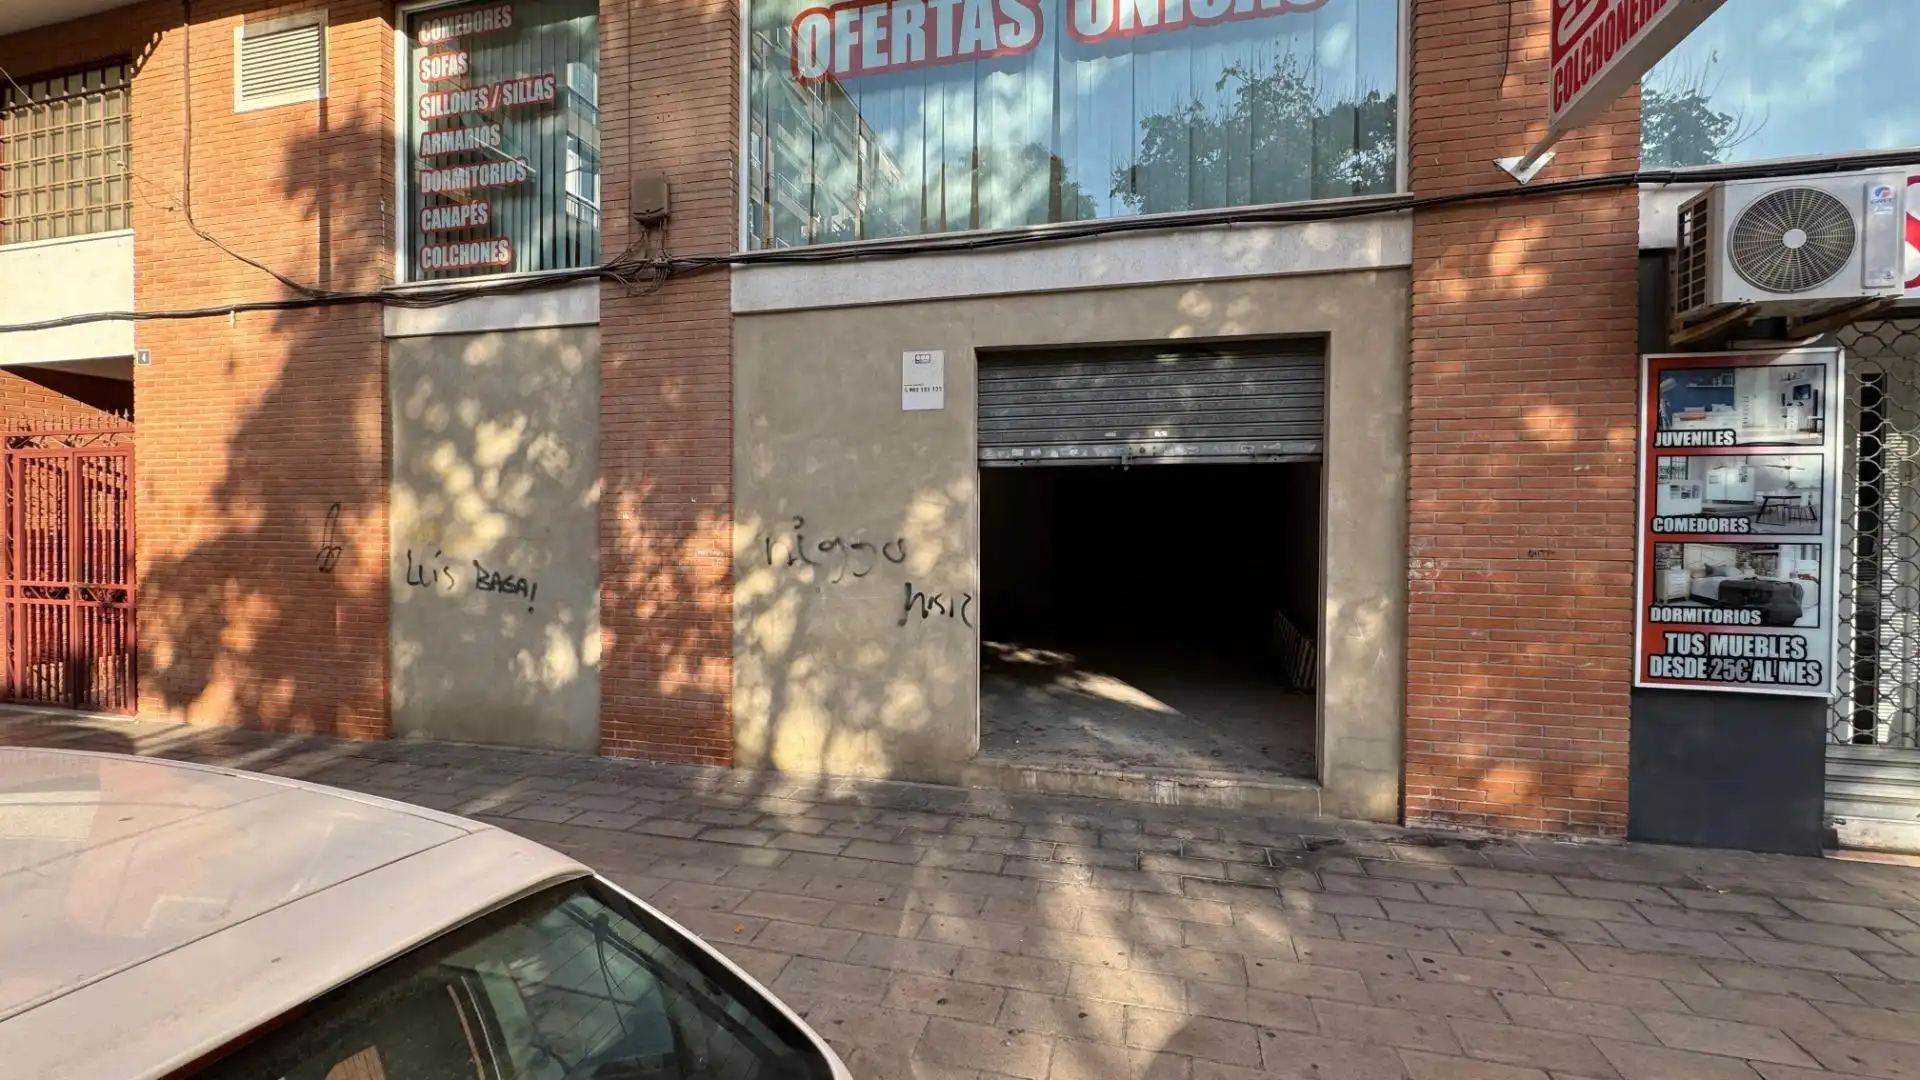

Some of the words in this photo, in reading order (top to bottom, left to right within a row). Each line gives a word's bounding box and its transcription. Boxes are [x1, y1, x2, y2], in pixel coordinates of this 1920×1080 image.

[420, 4, 513, 43] COMEDORES
[797, 0, 1037, 79] OFERTAS
[420, 51, 469, 82] SOFAS
[420, 87, 489, 120] SILLONES
[502, 76, 555, 106] SILLAS
[421, 123, 501, 157] ARMARIOS
[421, 158, 528, 194] DORMITORIOS
[421, 199, 489, 231] CANAPÉS
[421, 239, 510, 270] COLCHONES
[1654, 430, 1735, 448] JUVENILES
[1652, 516, 1749, 534] COMEDORES
[1649, 606, 1762, 626] DORMITORIOS
[1663, 632, 1706, 656] TUS
[1709, 633, 1806, 660] MUEBLES
[1649, 655, 1707, 679] DESDE
[1751, 660, 1775, 683] AL
[1778, 660, 1822, 686] MES
